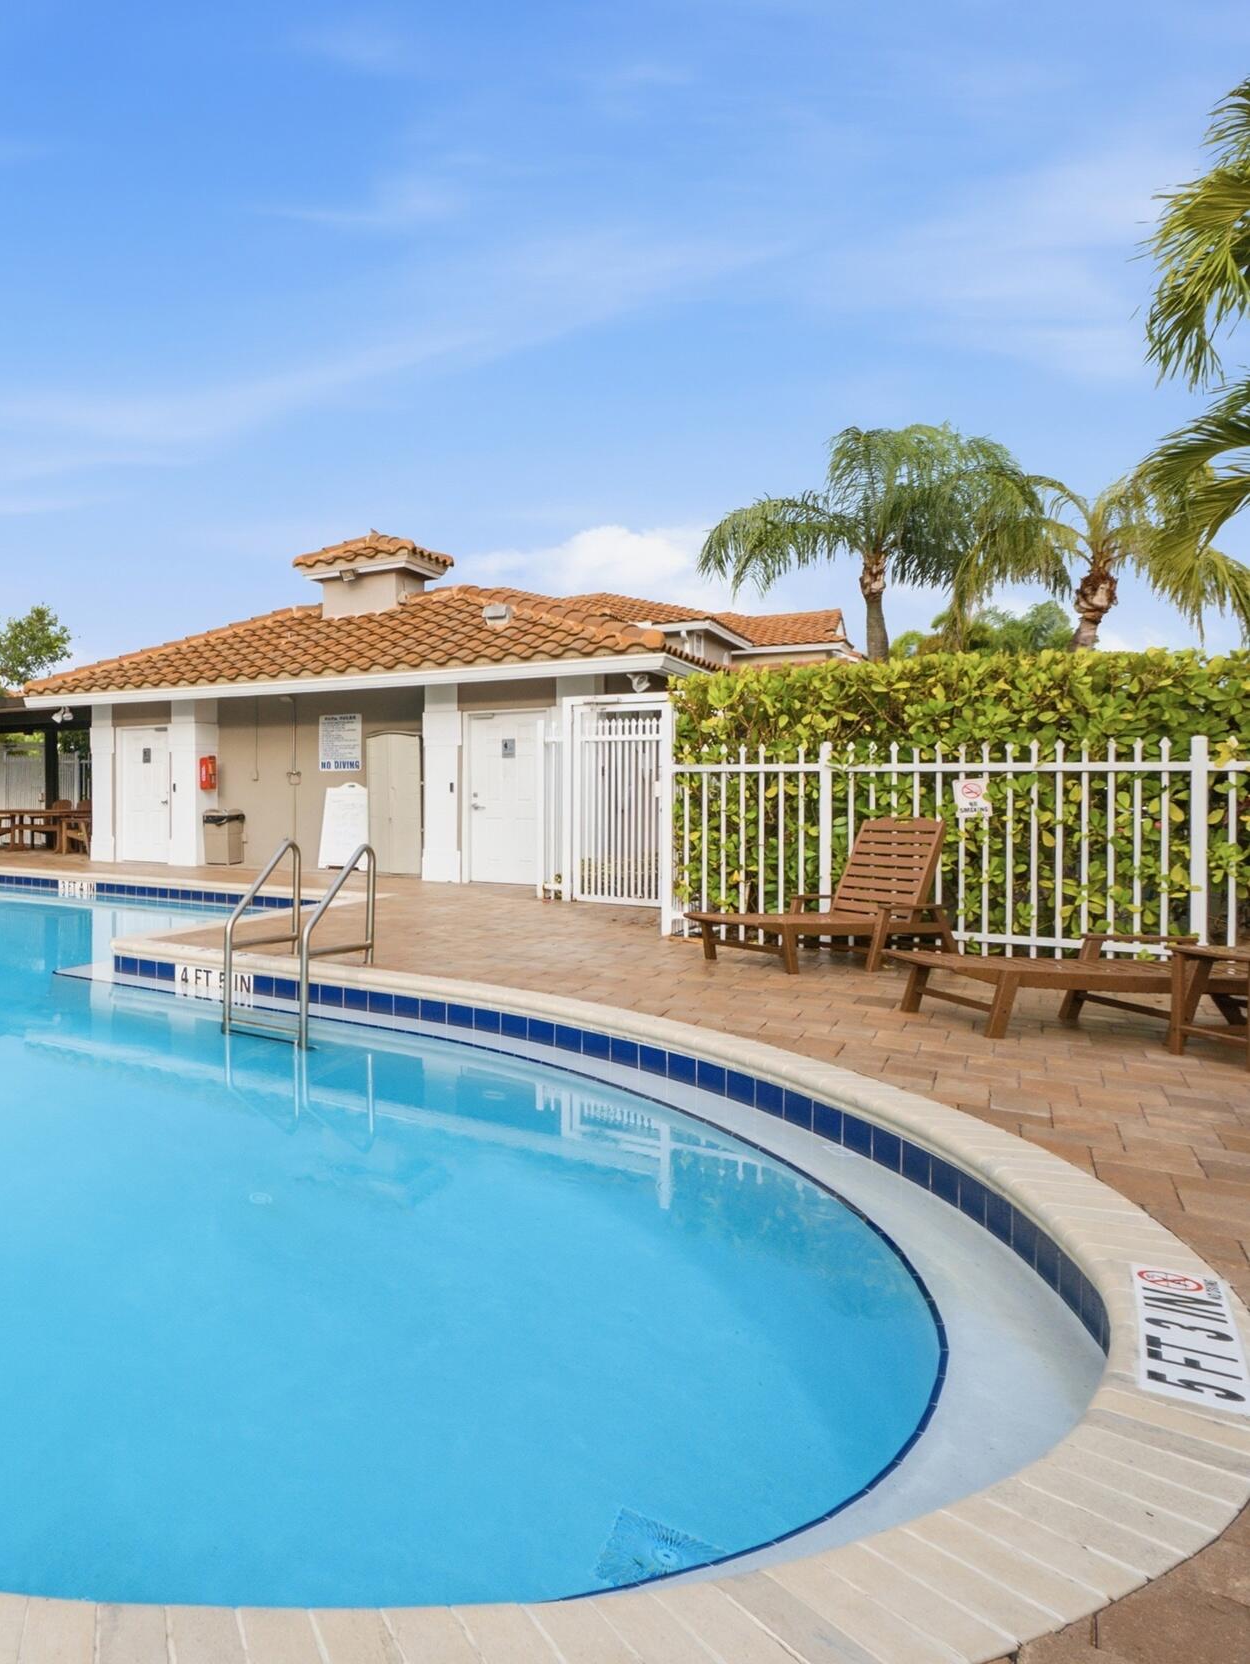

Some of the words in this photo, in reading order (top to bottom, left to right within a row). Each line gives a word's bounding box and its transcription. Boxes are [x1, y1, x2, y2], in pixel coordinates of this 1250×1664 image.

[321, 761, 331, 769] NO
[334, 761, 360, 769] DIVING
[181, 967, 189, 983] 4
[194, 968, 212, 987] FT
[234, 973, 251, 993] IN
[1142, 1286, 1229, 1324] IN
[1145, 1317, 1234, 1343] 3
[1146, 1334, 1243, 1381] FT
[1147, 1369, 1246, 1402] 5
